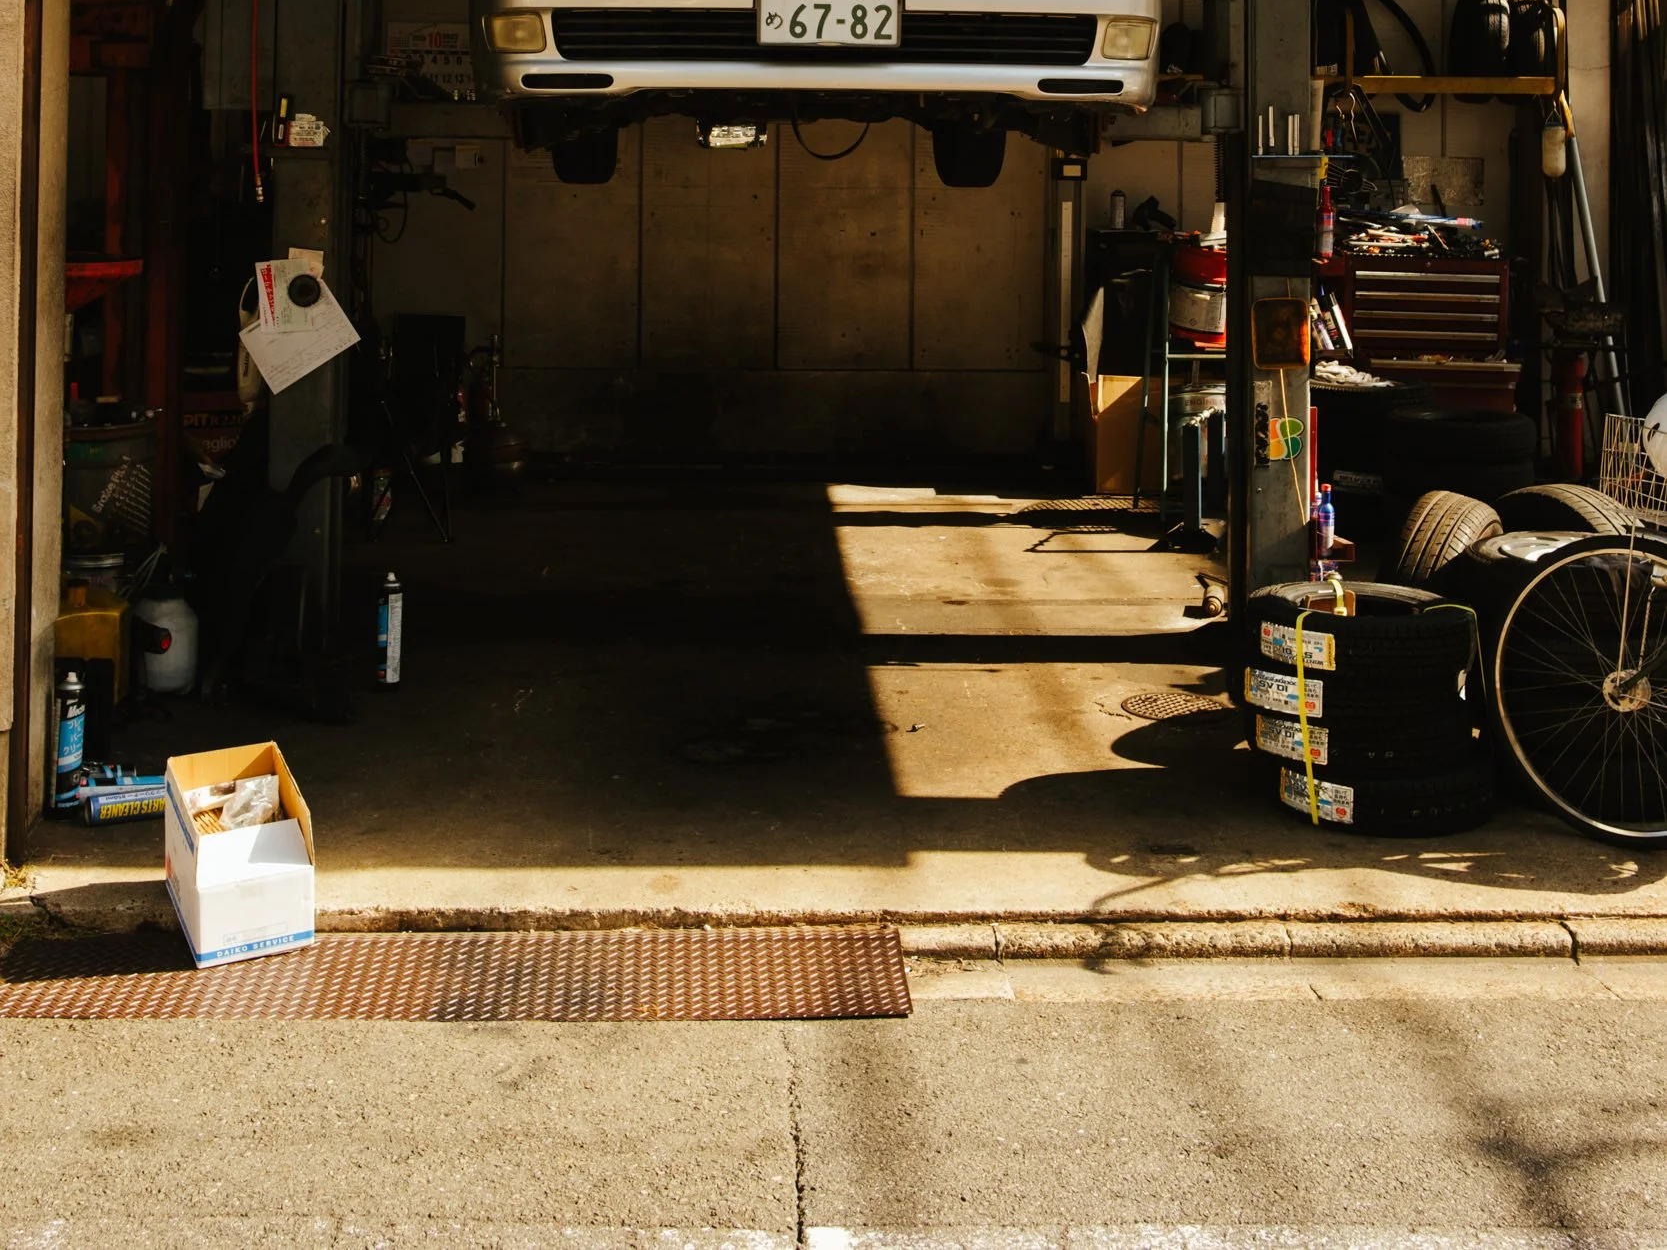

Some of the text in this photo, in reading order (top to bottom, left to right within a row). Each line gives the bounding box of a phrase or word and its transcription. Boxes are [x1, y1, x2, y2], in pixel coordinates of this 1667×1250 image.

[765, 3, 893, 40] め 67-82
[428, 32, 442, 48] 10
[443, 55, 450, 65] 5
[443, 74, 452, 84] 12
[100, 801, 140, 821] CLEANER
[141, 798, 166, 815] ARTS
[216, 945, 248, 958] DAIKO
[252, 934, 296, 950] SERVICE
